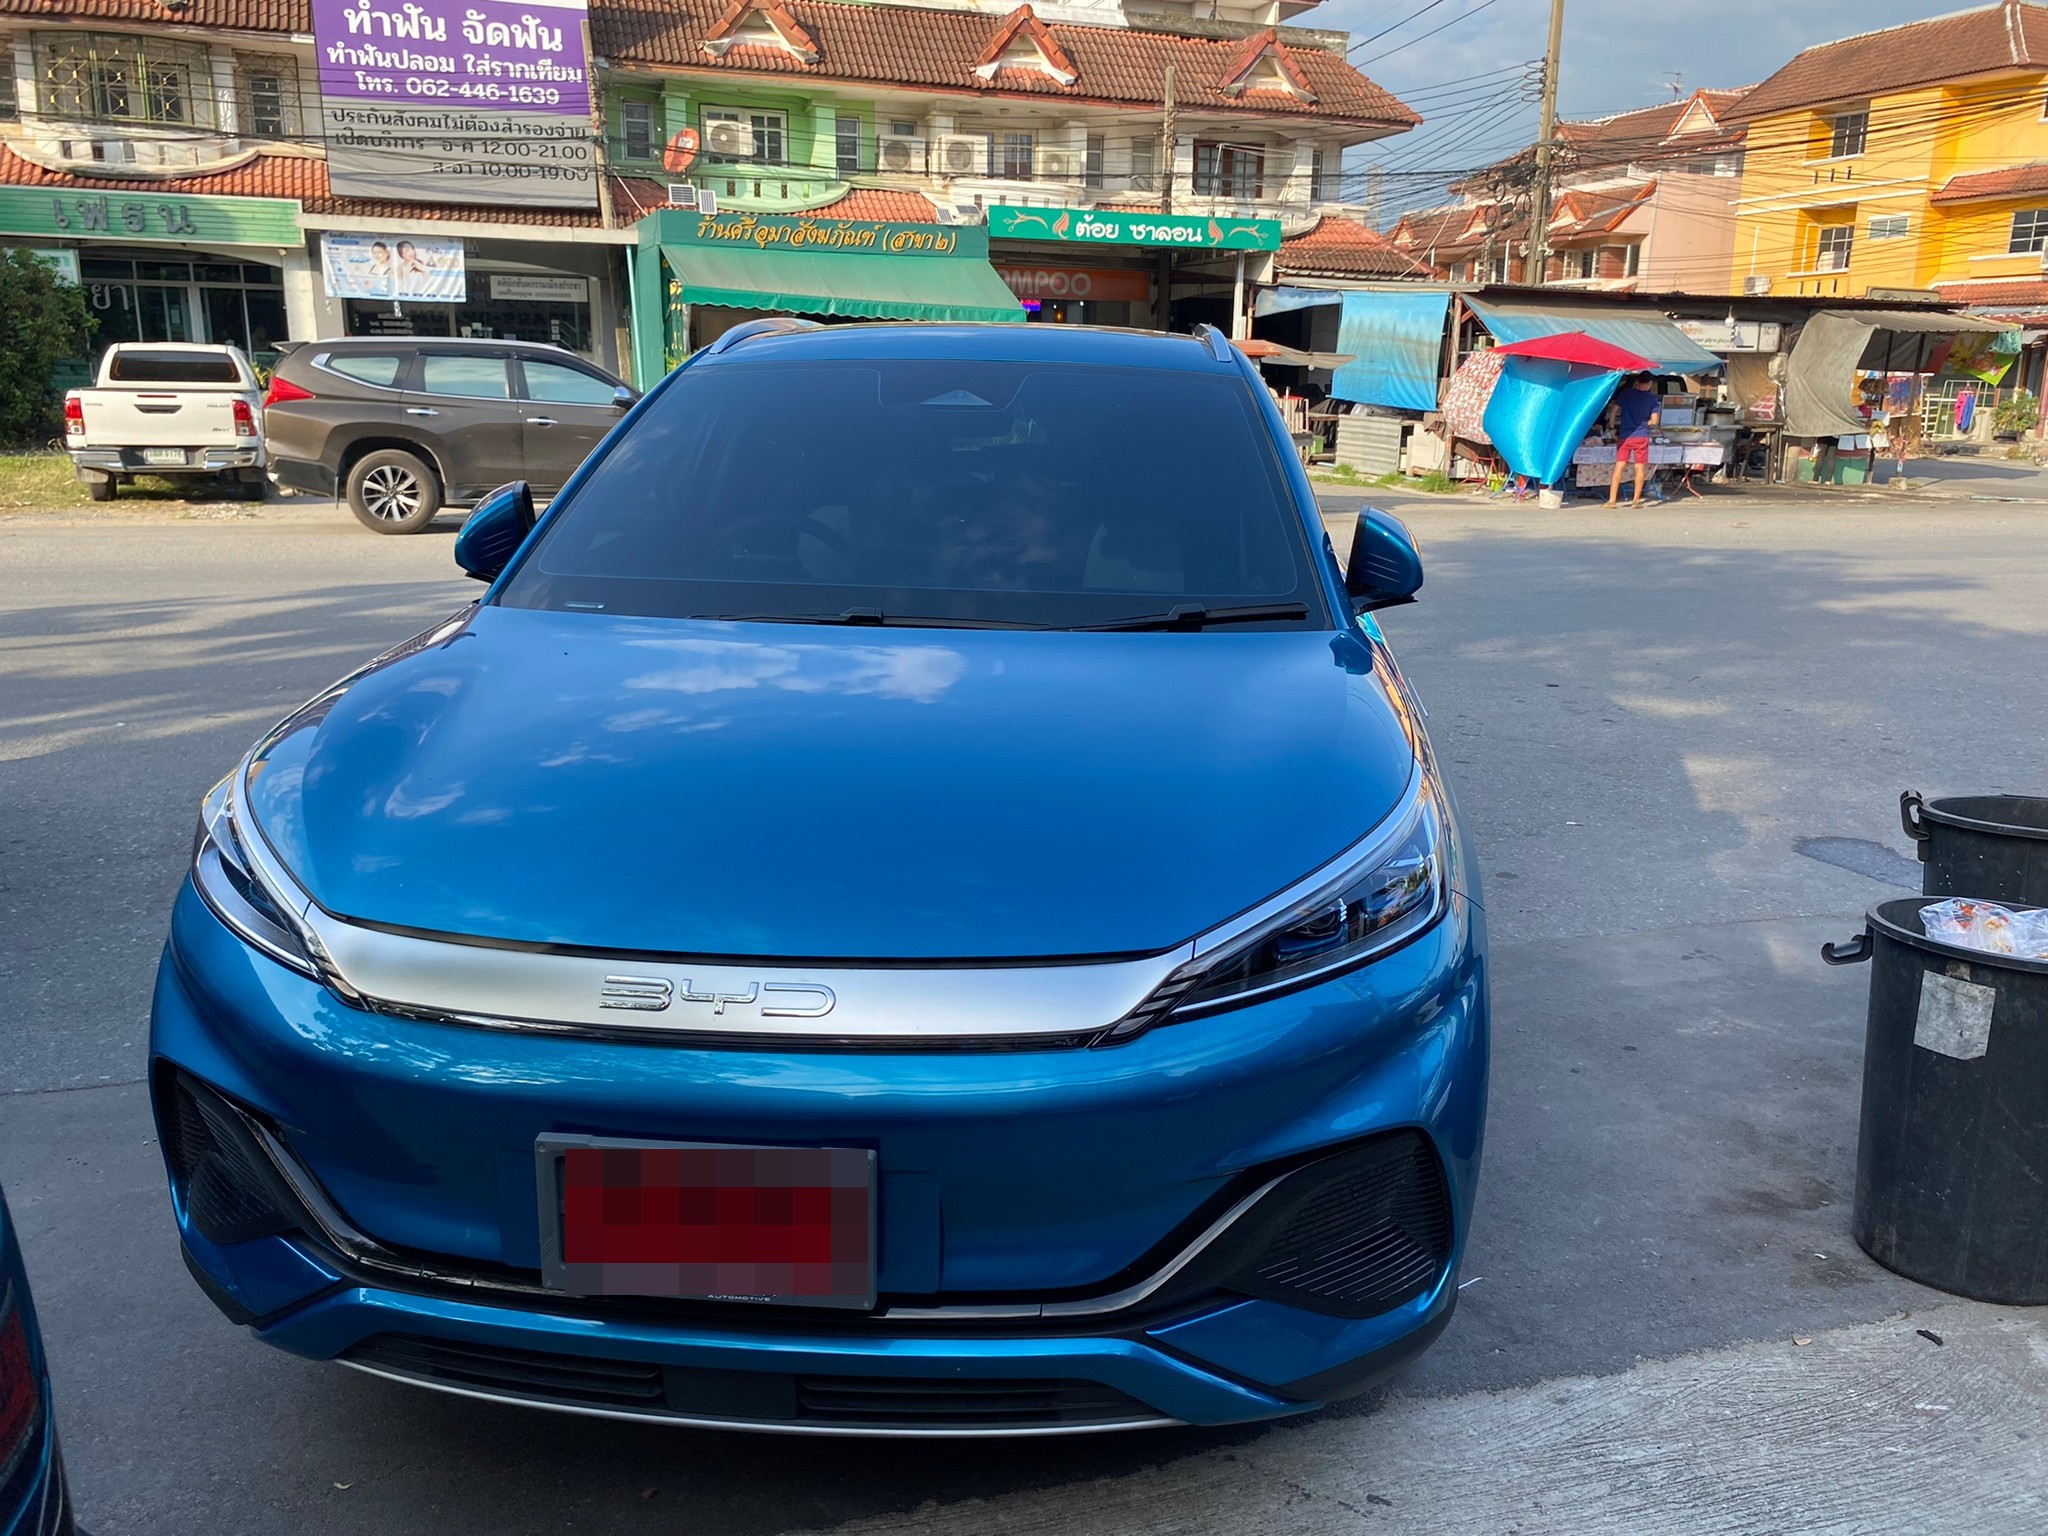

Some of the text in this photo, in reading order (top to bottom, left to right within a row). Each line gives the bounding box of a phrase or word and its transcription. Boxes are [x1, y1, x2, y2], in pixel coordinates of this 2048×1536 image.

[343, 0, 563, 52] ทำฟัน จัดฟัน
[326, 41, 583, 83] ทำฟันปลอม ใส่รากเทียม
[355, 70, 560, 105] โทร. 062-446-1639
[335, 127, 425, 149] เปิดบริการ
[481, 141, 587, 160] 12.00-21.00
[481, 163, 588, 182] 10.00-19.00
[1075, 214, 1203, 243] ต้อย ซาลอน
[599, 974, 837, 1018] BYD
[707, 1294, 771, 1302] AUTOMOTIVE
